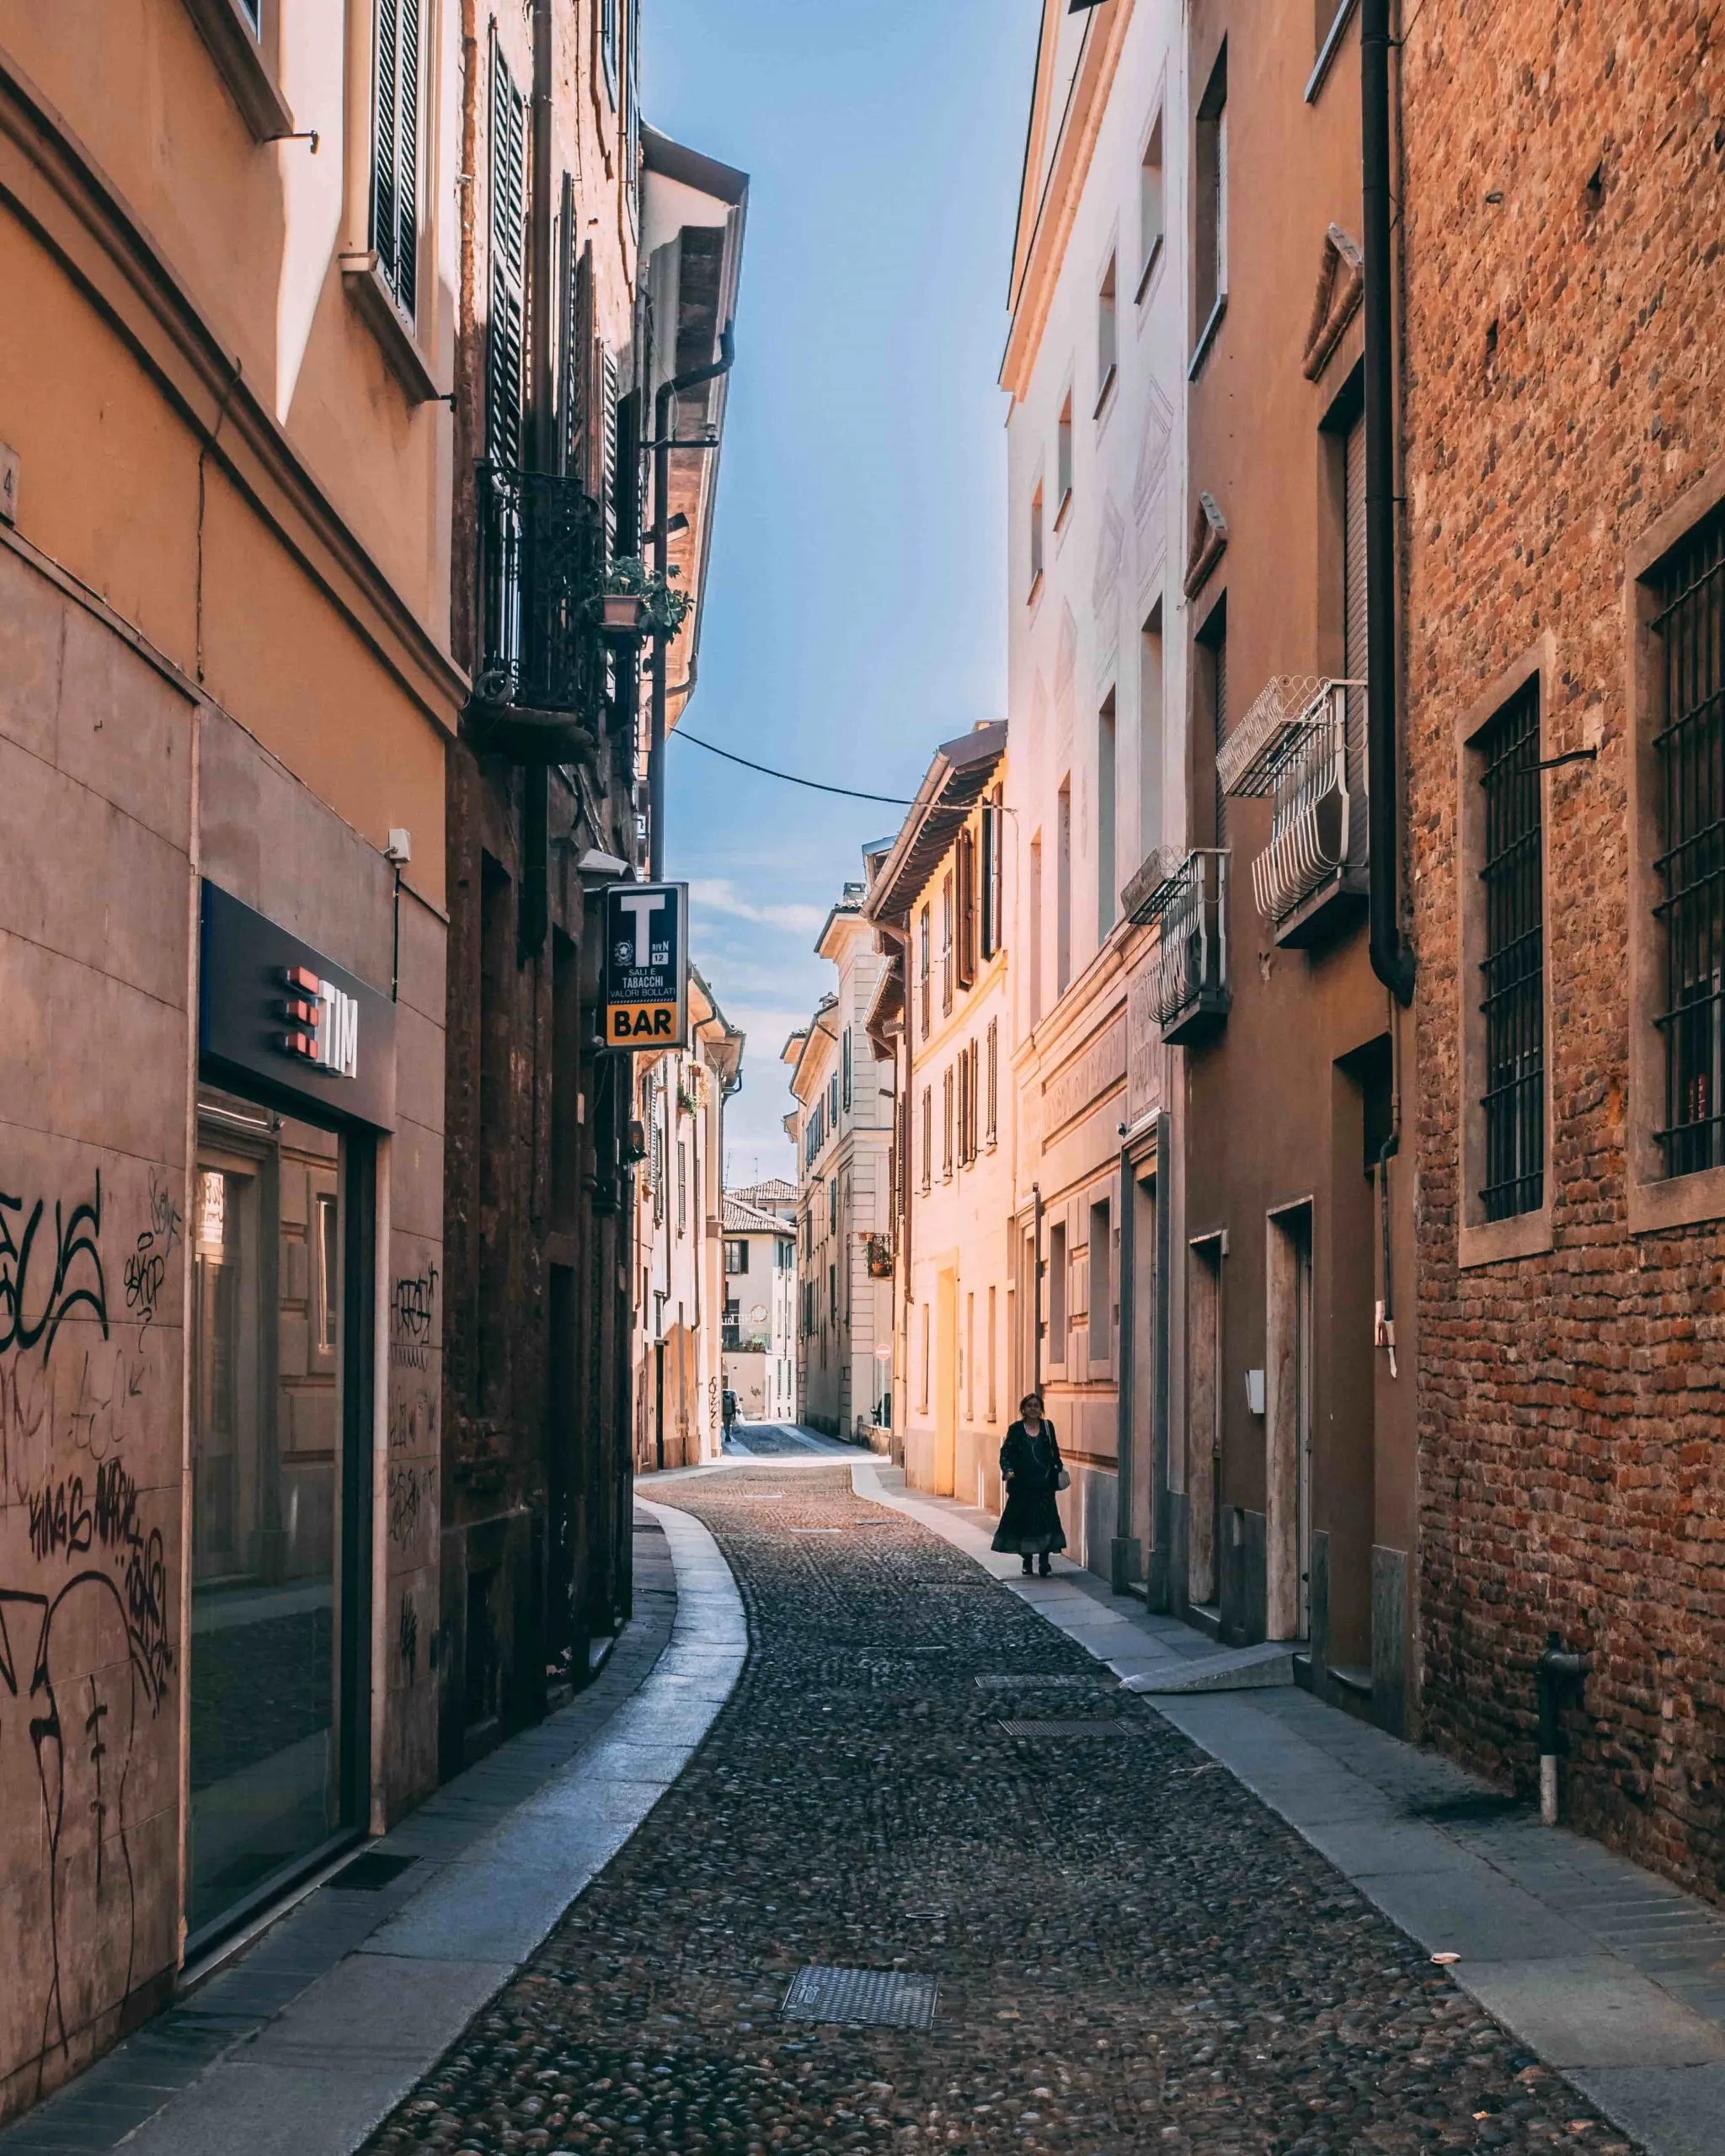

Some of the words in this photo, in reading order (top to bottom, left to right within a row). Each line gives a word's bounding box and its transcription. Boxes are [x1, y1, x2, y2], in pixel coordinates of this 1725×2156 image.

[621, 894, 665, 967] T
[610, 989, 639, 998] VALORI
[642, 987, 676, 996] BOLLATI
[622, 976, 664, 989] TABACCHI
[316, 979, 358, 1079] TIM
[614, 1009, 671, 1037] BAR
